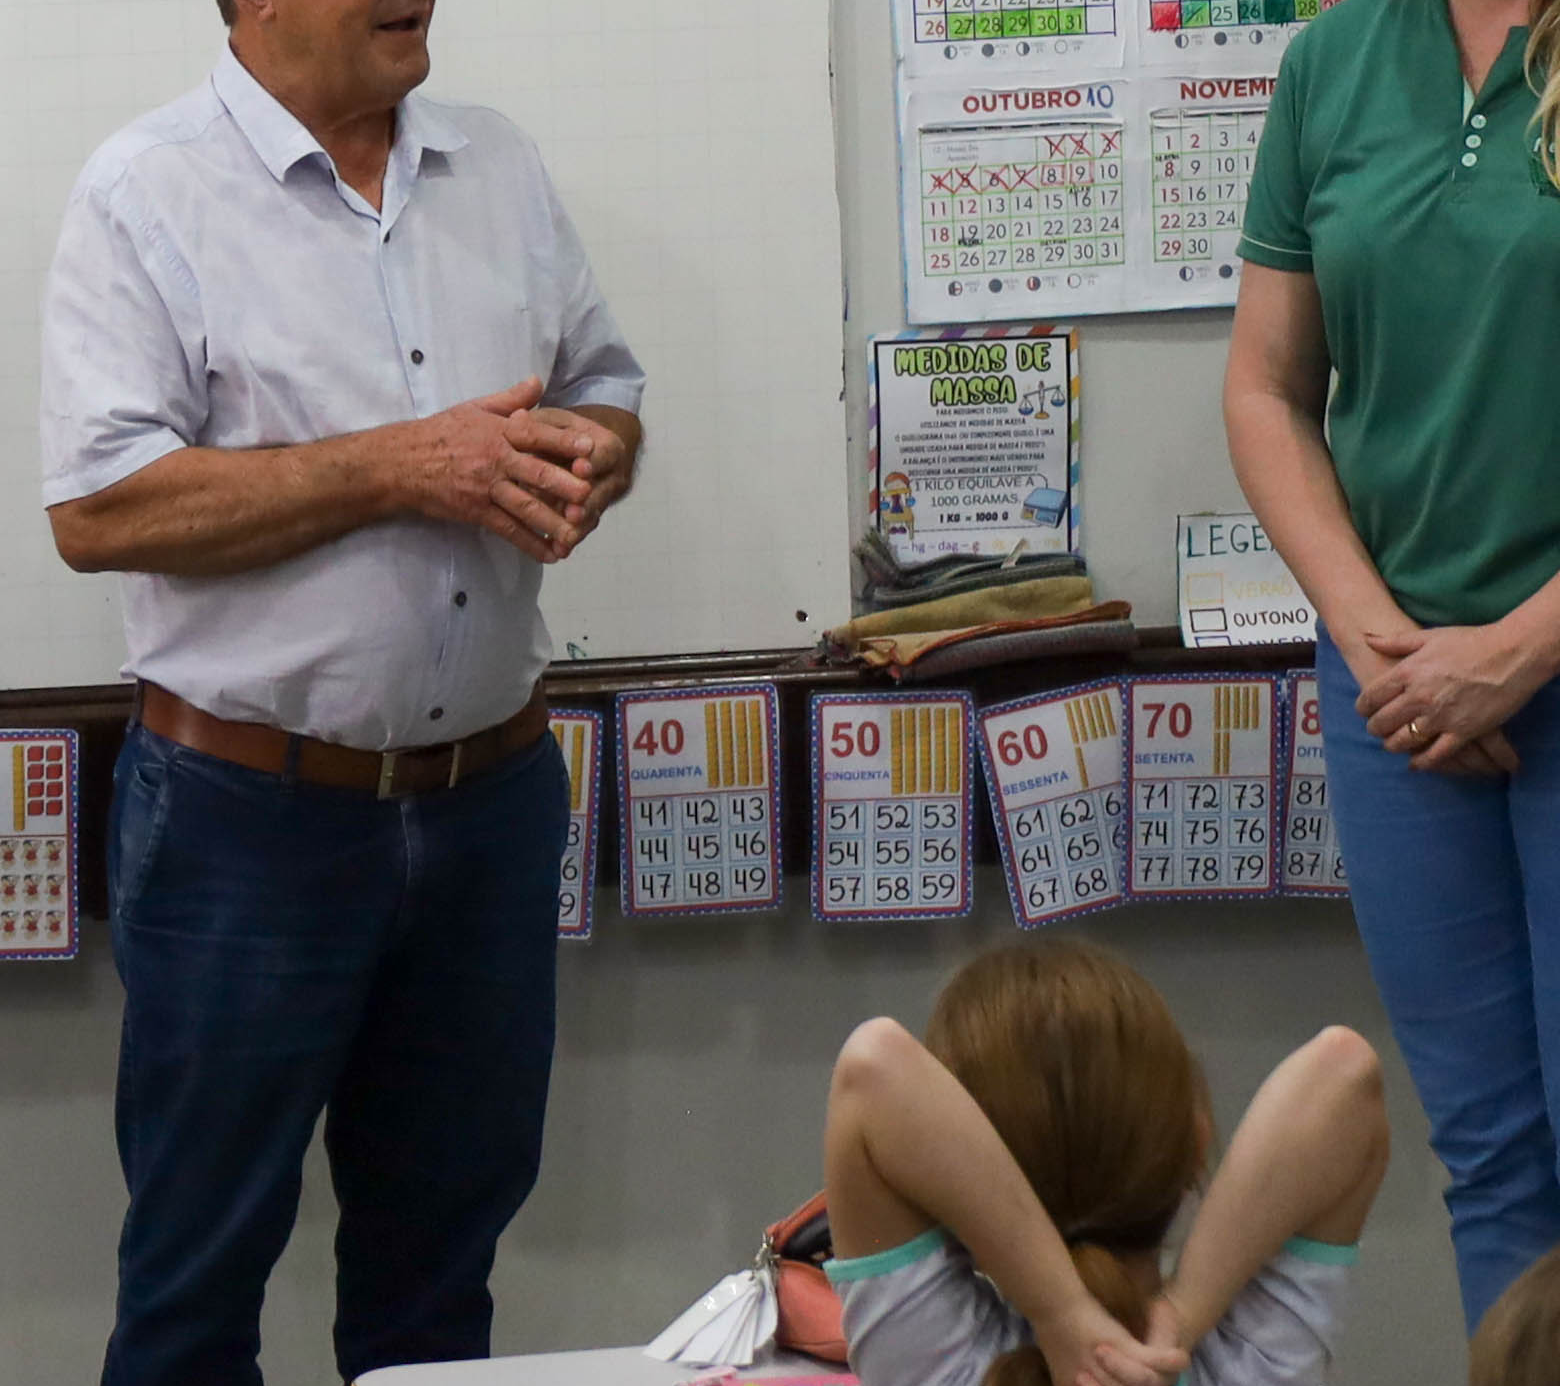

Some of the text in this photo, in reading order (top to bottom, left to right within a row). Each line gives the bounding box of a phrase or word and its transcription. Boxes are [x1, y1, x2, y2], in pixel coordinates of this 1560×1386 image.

[962, 89, 1081, 113] OUTUBRO
[895, 343, 1051, 376] MEDIDAS DE
[931, 376, 1016, 406] MASSA
[1233, 608, 1308, 627] OUTONO
[1142, 702, 1193, 740] 70
[632, 718, 685, 758] 40
[830, 720, 881, 759] 50
[997, 723, 1049, 767] 60
[1134, 751, 1196, 765] SETENTA
[630, 765, 703, 781] QUARENTA
[824, 769, 890, 782] CINQUENTA
[1001, 771, 1070, 798] SESSENTA
